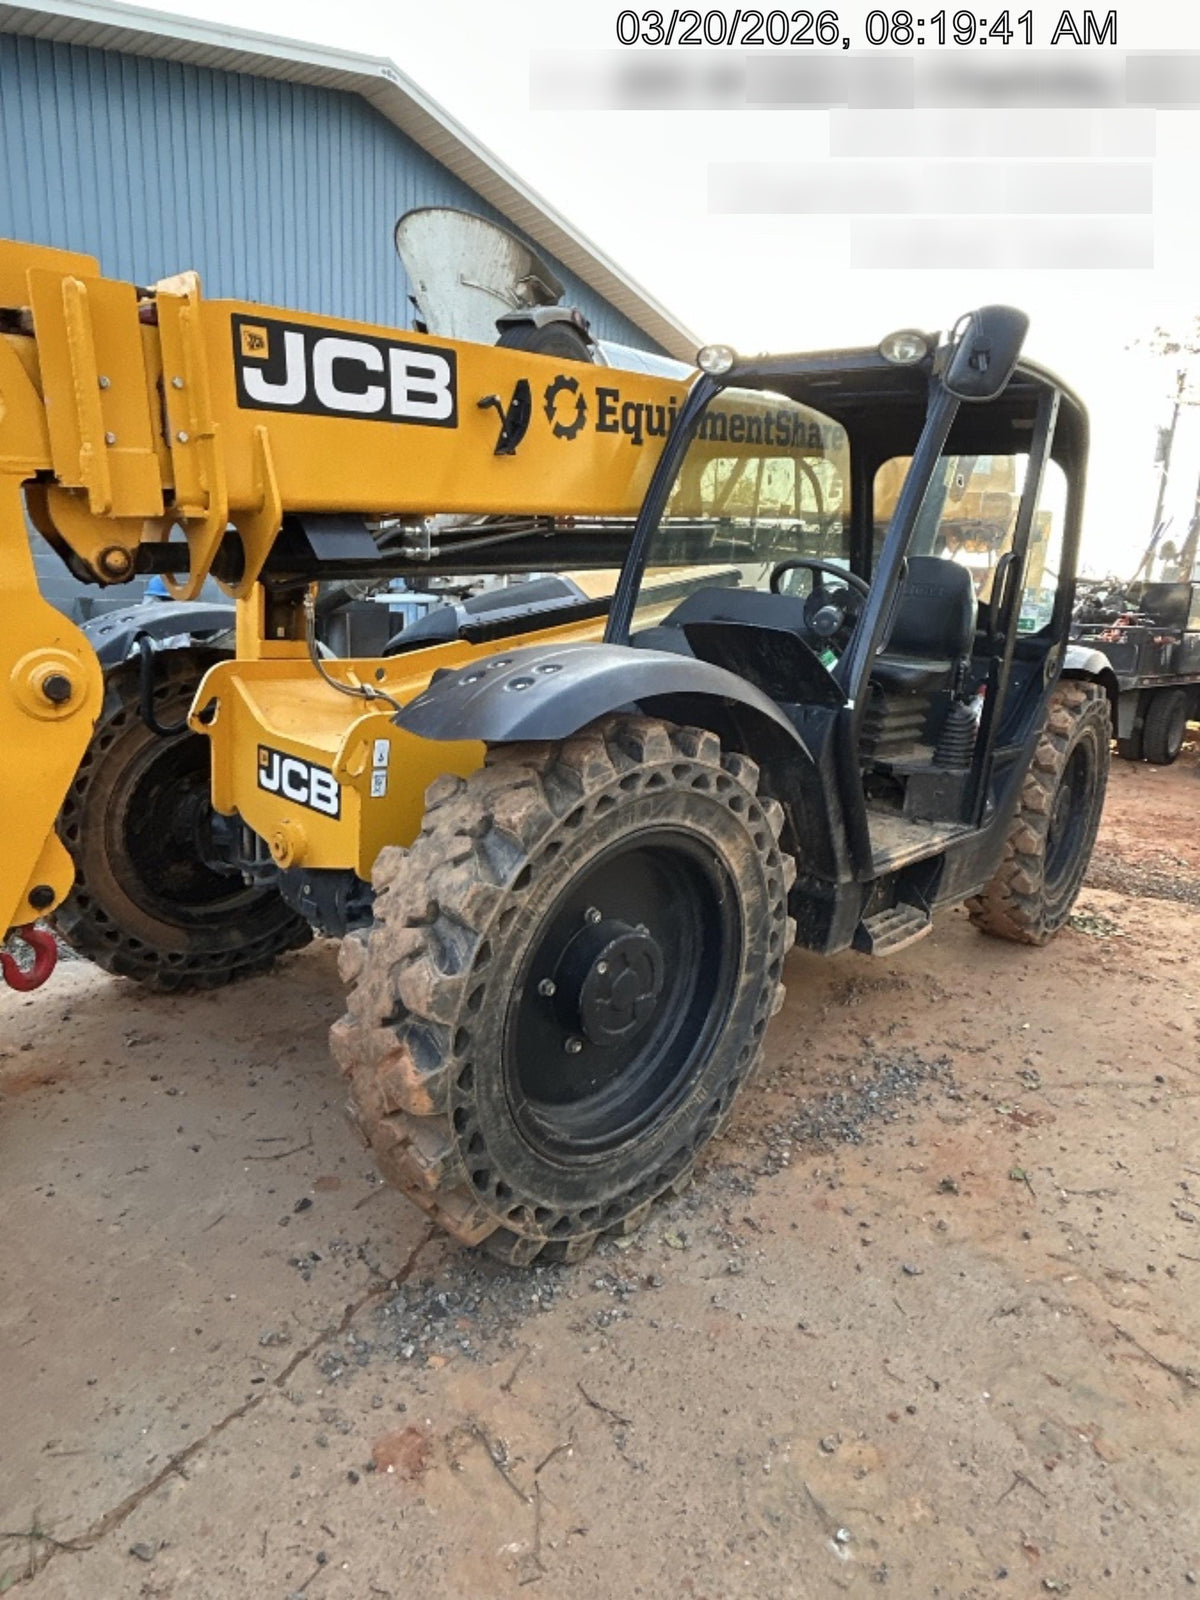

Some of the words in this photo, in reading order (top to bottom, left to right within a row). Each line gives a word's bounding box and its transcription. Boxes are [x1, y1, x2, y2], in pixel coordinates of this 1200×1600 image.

[243, 331, 453, 420] JCB
[595, 387, 845, 450] EquimentShare
[260, 753, 338, 815] JCB
